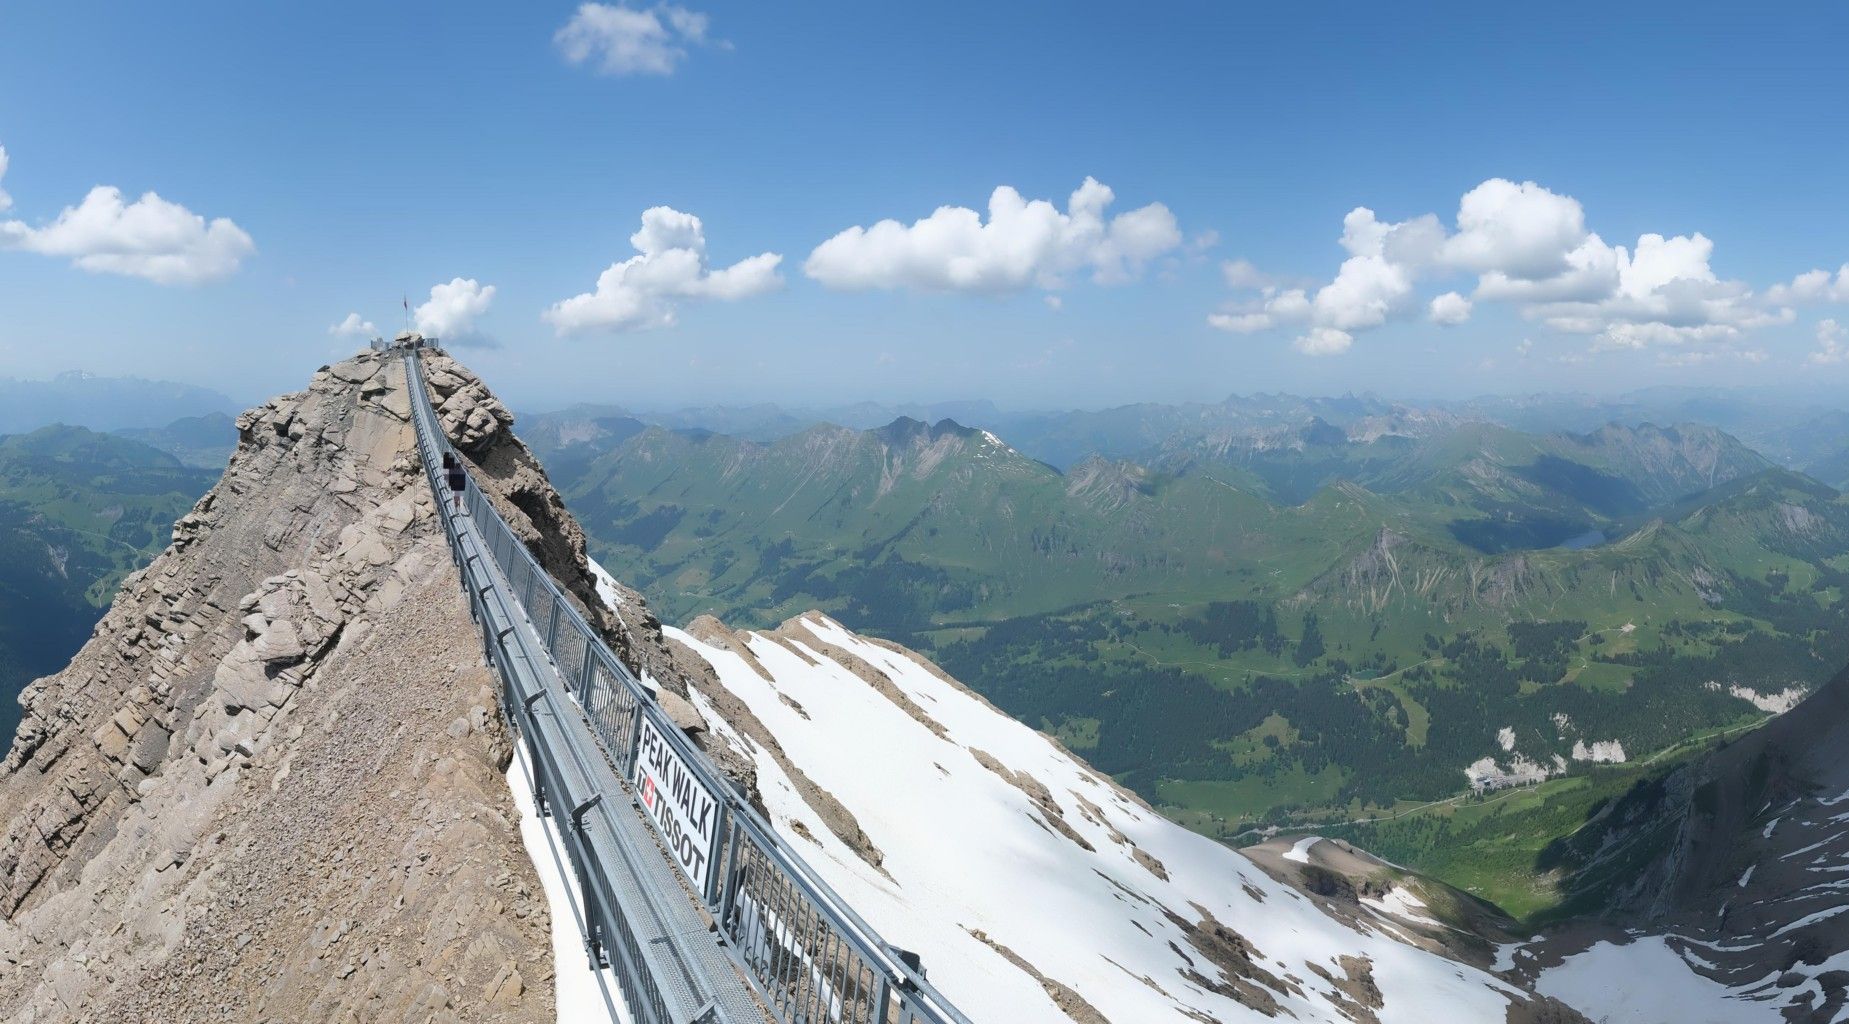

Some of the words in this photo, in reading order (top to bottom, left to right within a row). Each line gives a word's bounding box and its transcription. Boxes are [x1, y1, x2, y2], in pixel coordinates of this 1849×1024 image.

[642, 724, 673, 788] PEAK
[672, 760, 711, 842] WALK
[653, 787, 705, 881] TISSOT
